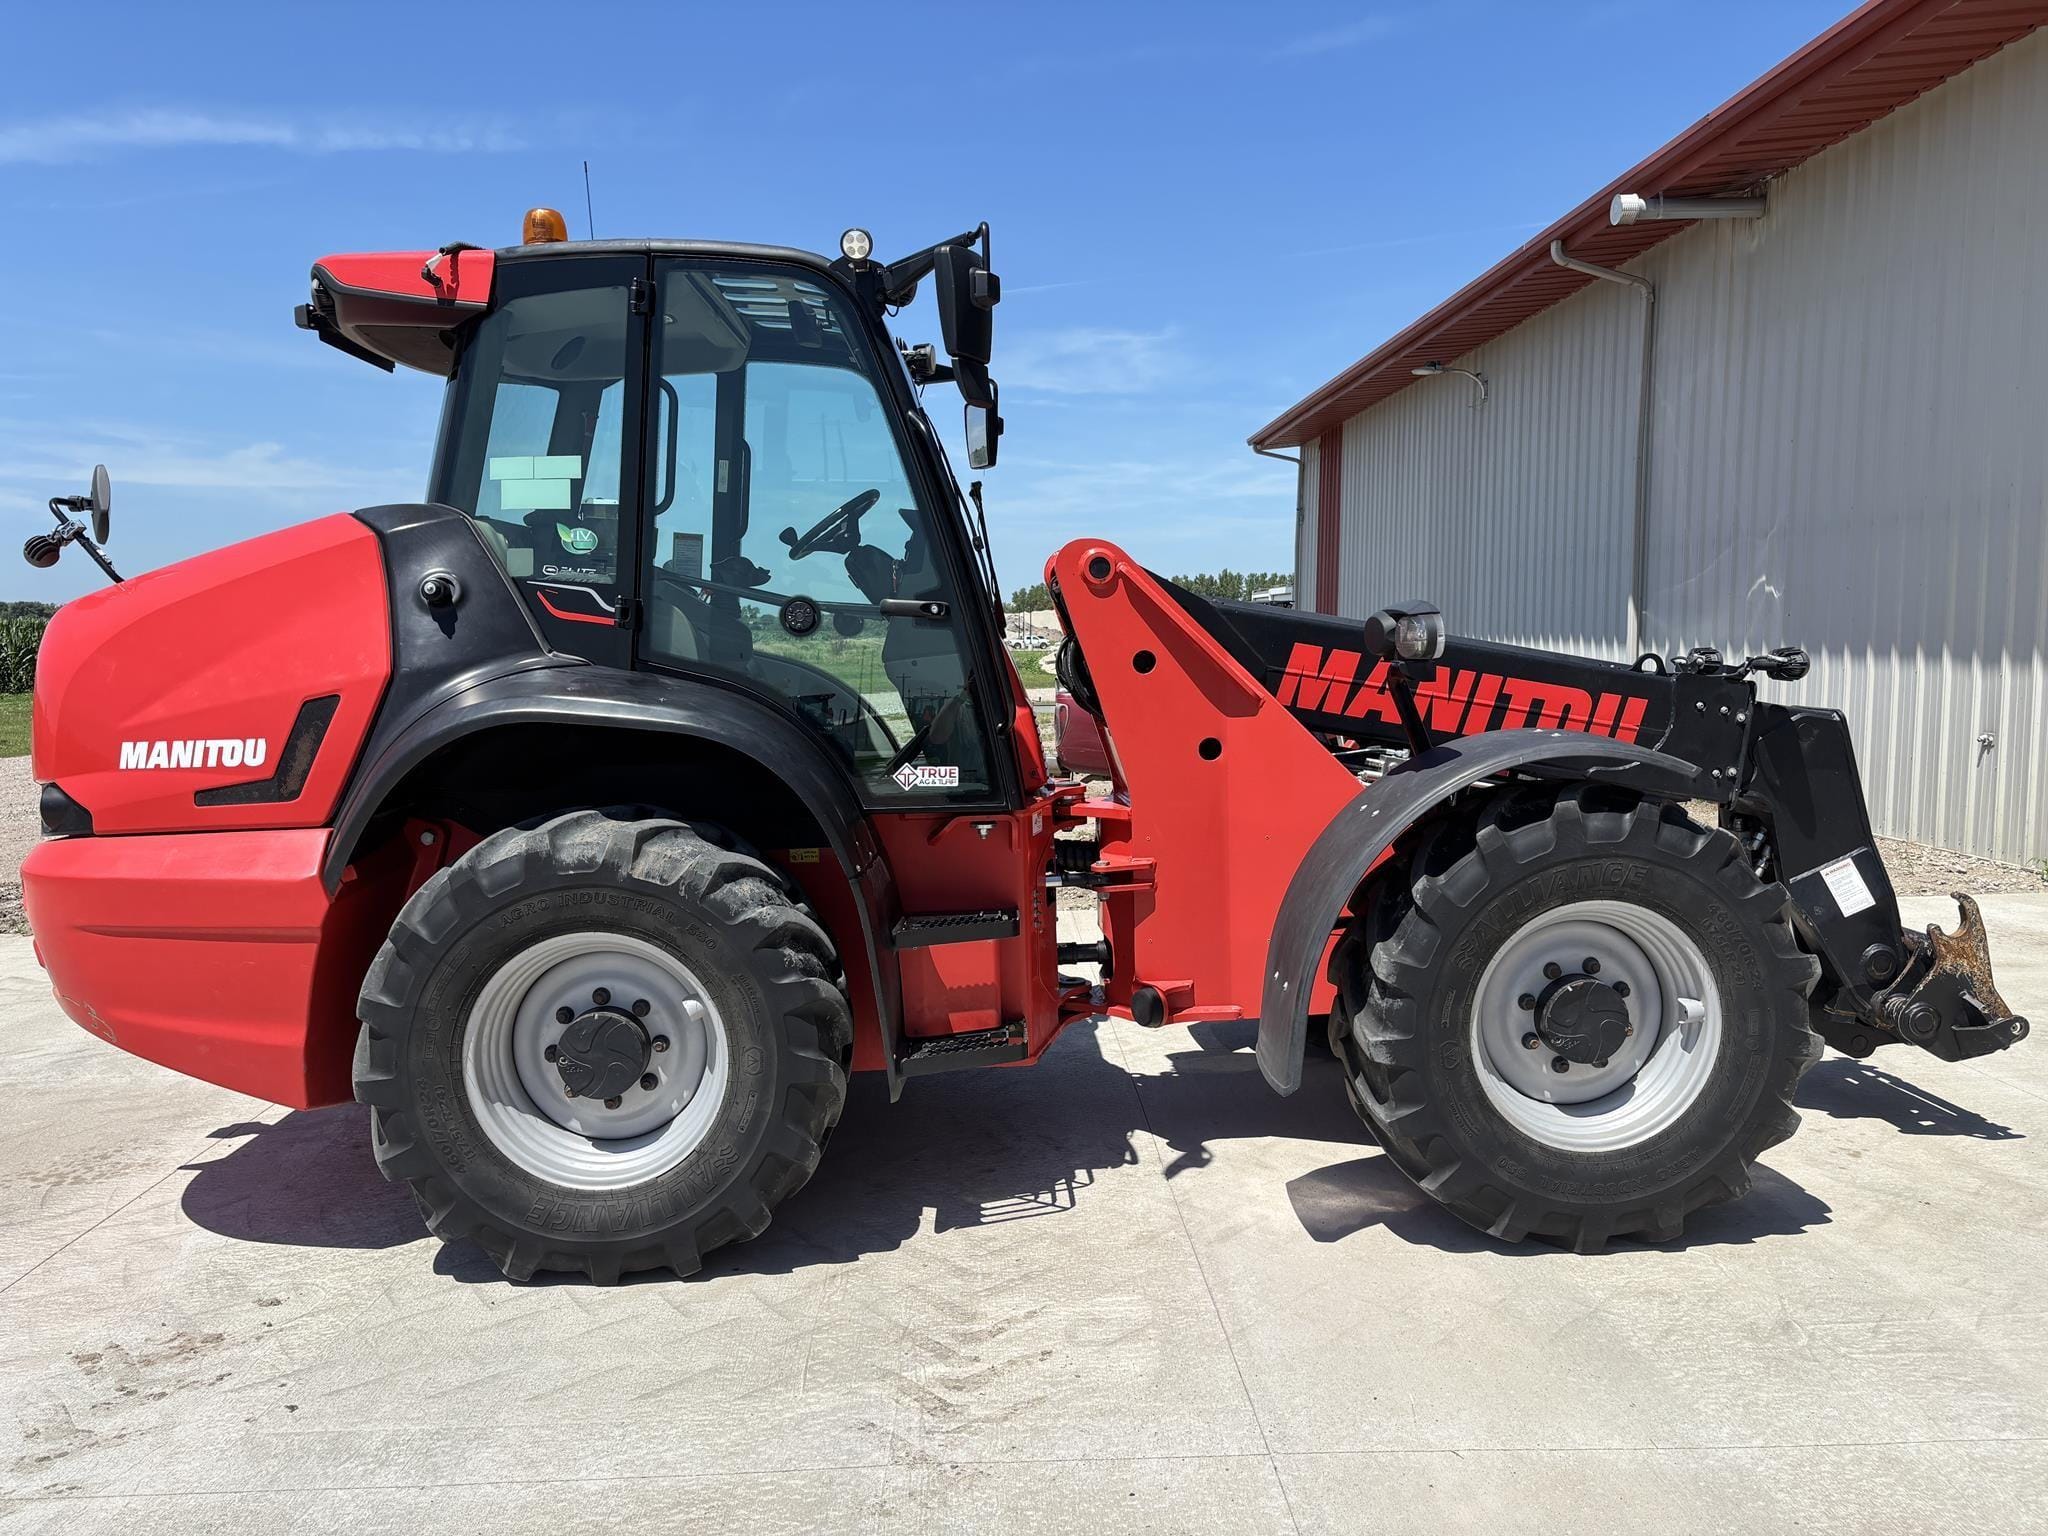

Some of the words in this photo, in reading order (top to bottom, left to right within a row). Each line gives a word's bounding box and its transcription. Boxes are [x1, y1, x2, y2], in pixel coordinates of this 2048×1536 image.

[1275, 642, 1649, 744] MANITOU
[119, 738, 266, 769] MANITOU
[919, 768, 957, 778] TRUE
[501, 896, 552, 928] AGRO
[558, 891, 675, 922] INDUSTRIAL
[1473, 861, 1649, 947] ALLIANCE
[522, 1158, 719, 1234] ALLIANCE
